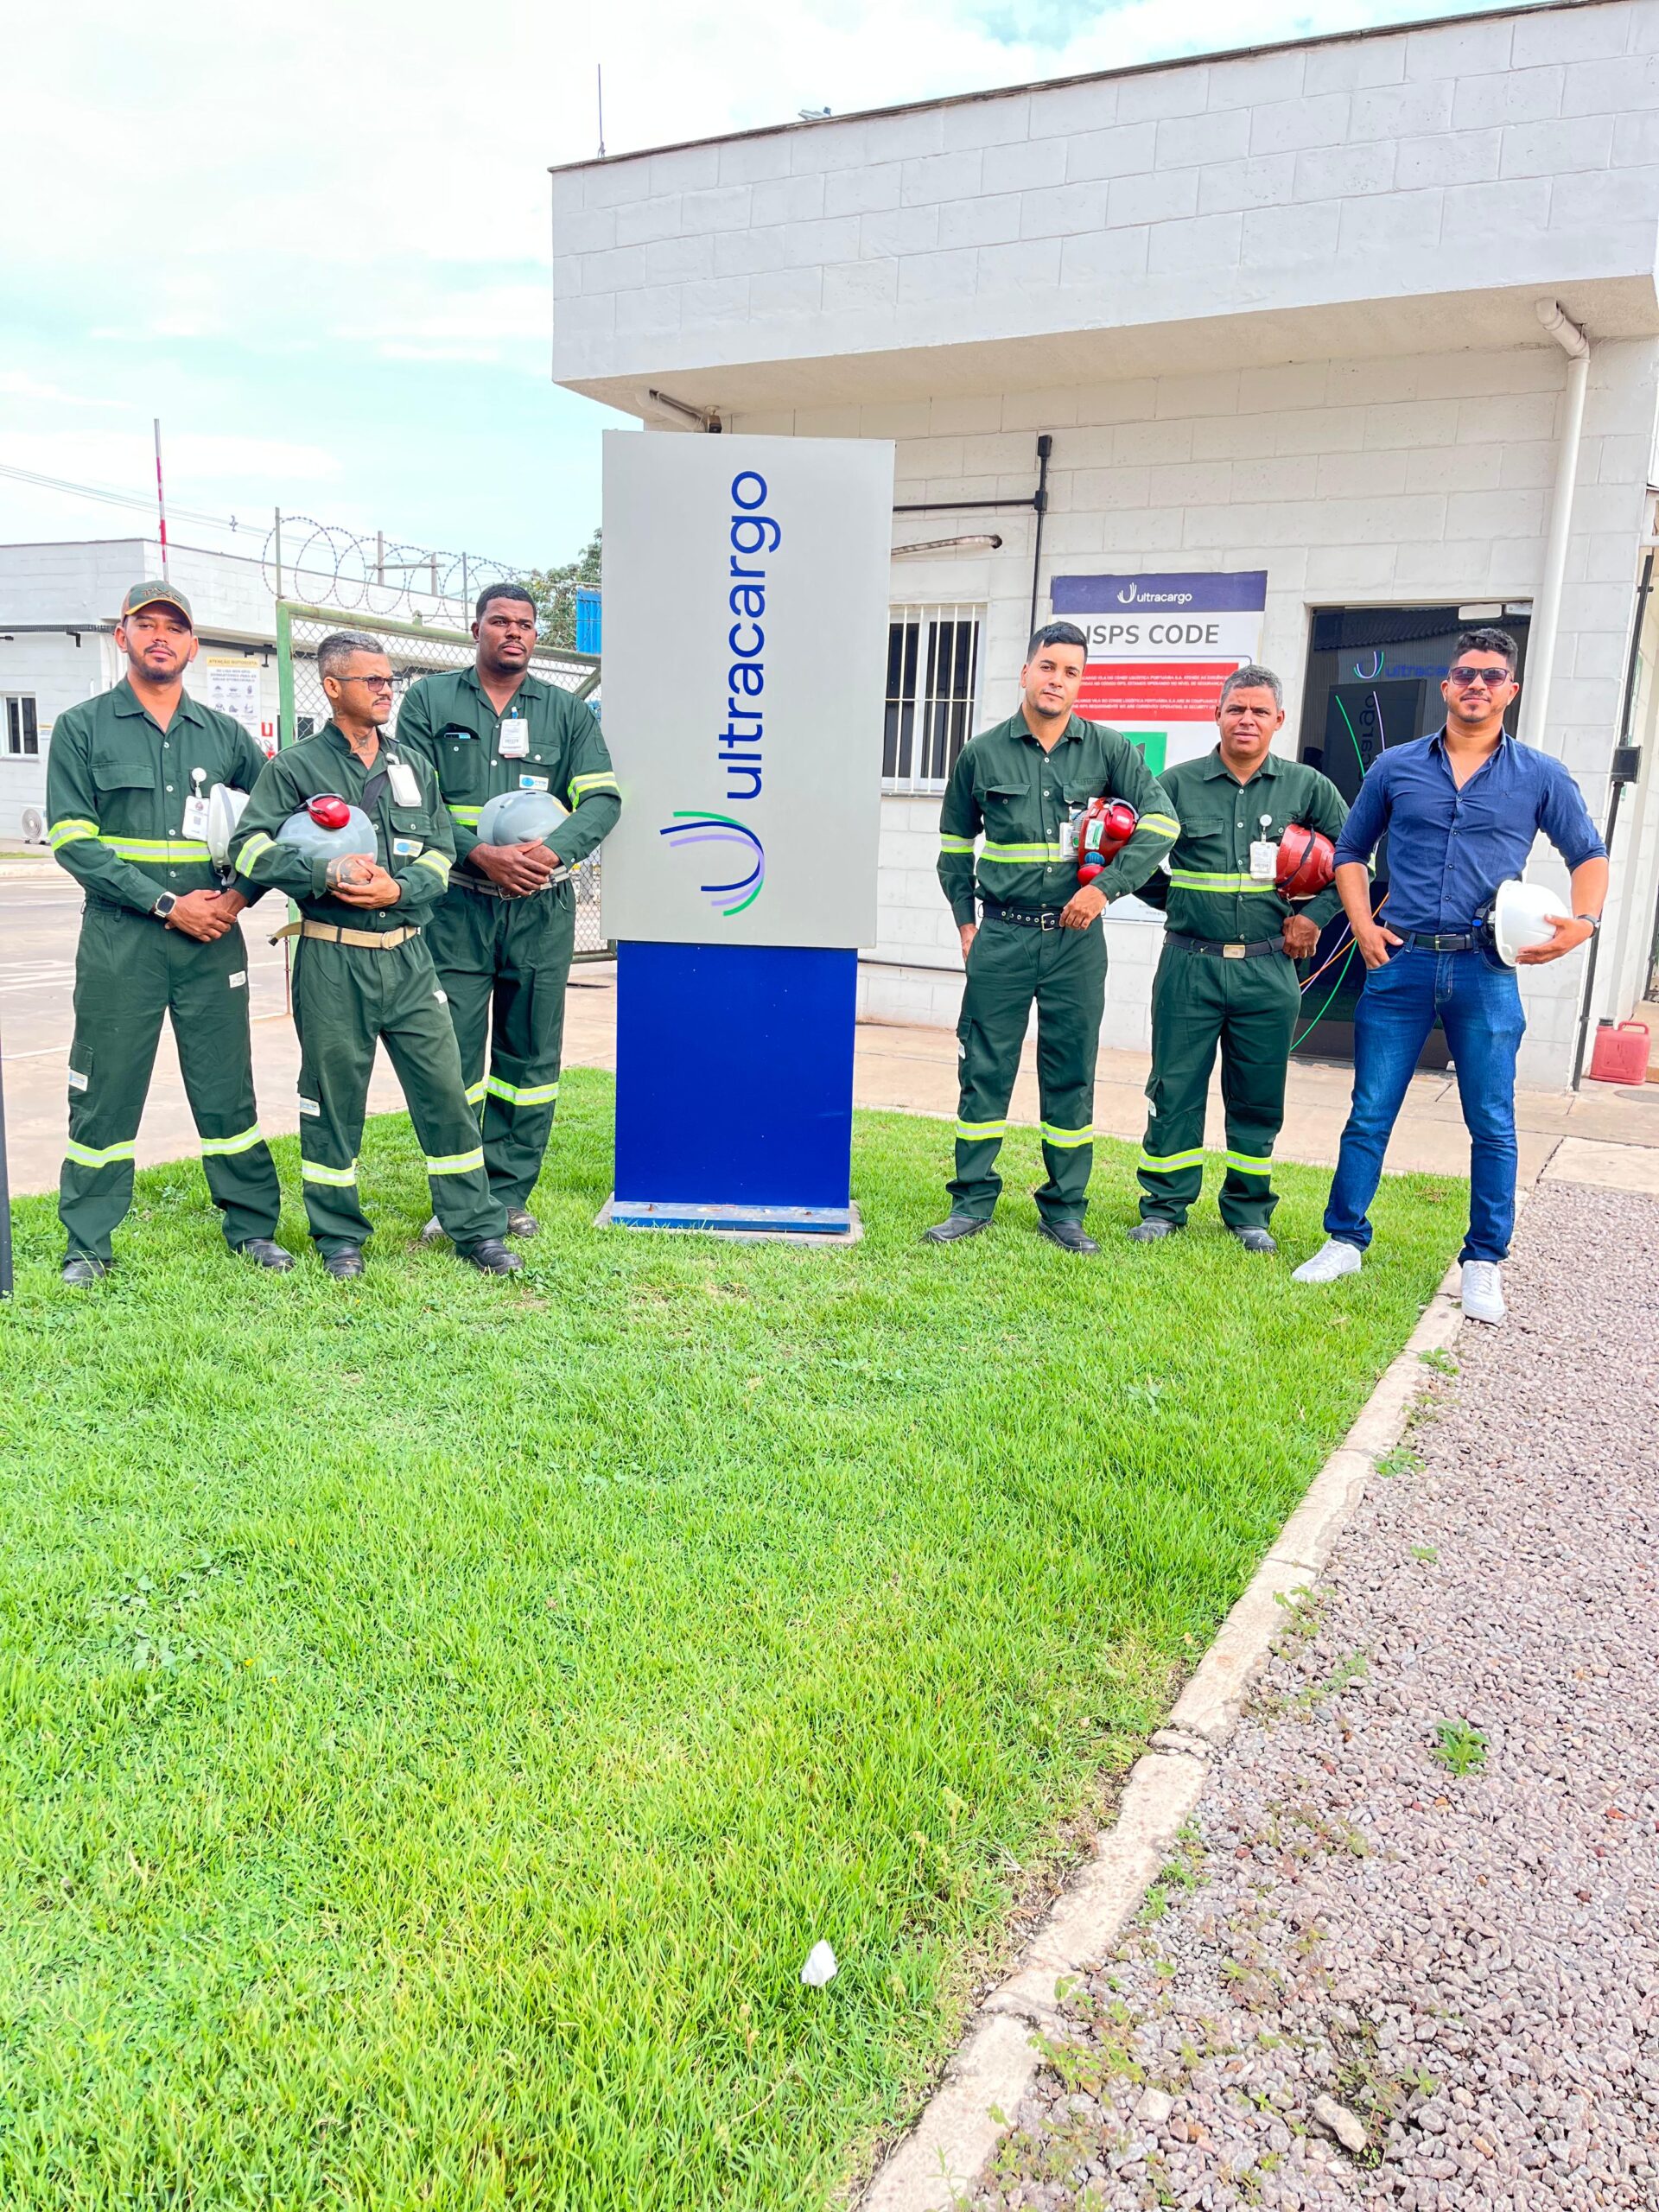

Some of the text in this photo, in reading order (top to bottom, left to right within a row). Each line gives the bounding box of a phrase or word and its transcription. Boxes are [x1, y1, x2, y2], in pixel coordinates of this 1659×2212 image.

[1136, 592, 1192, 604] ultracargo
[718, 470, 781, 799] ultracargo
[1086, 624, 1219, 645] ISPS CODE
[1385, 664, 1450, 677] ultraca
